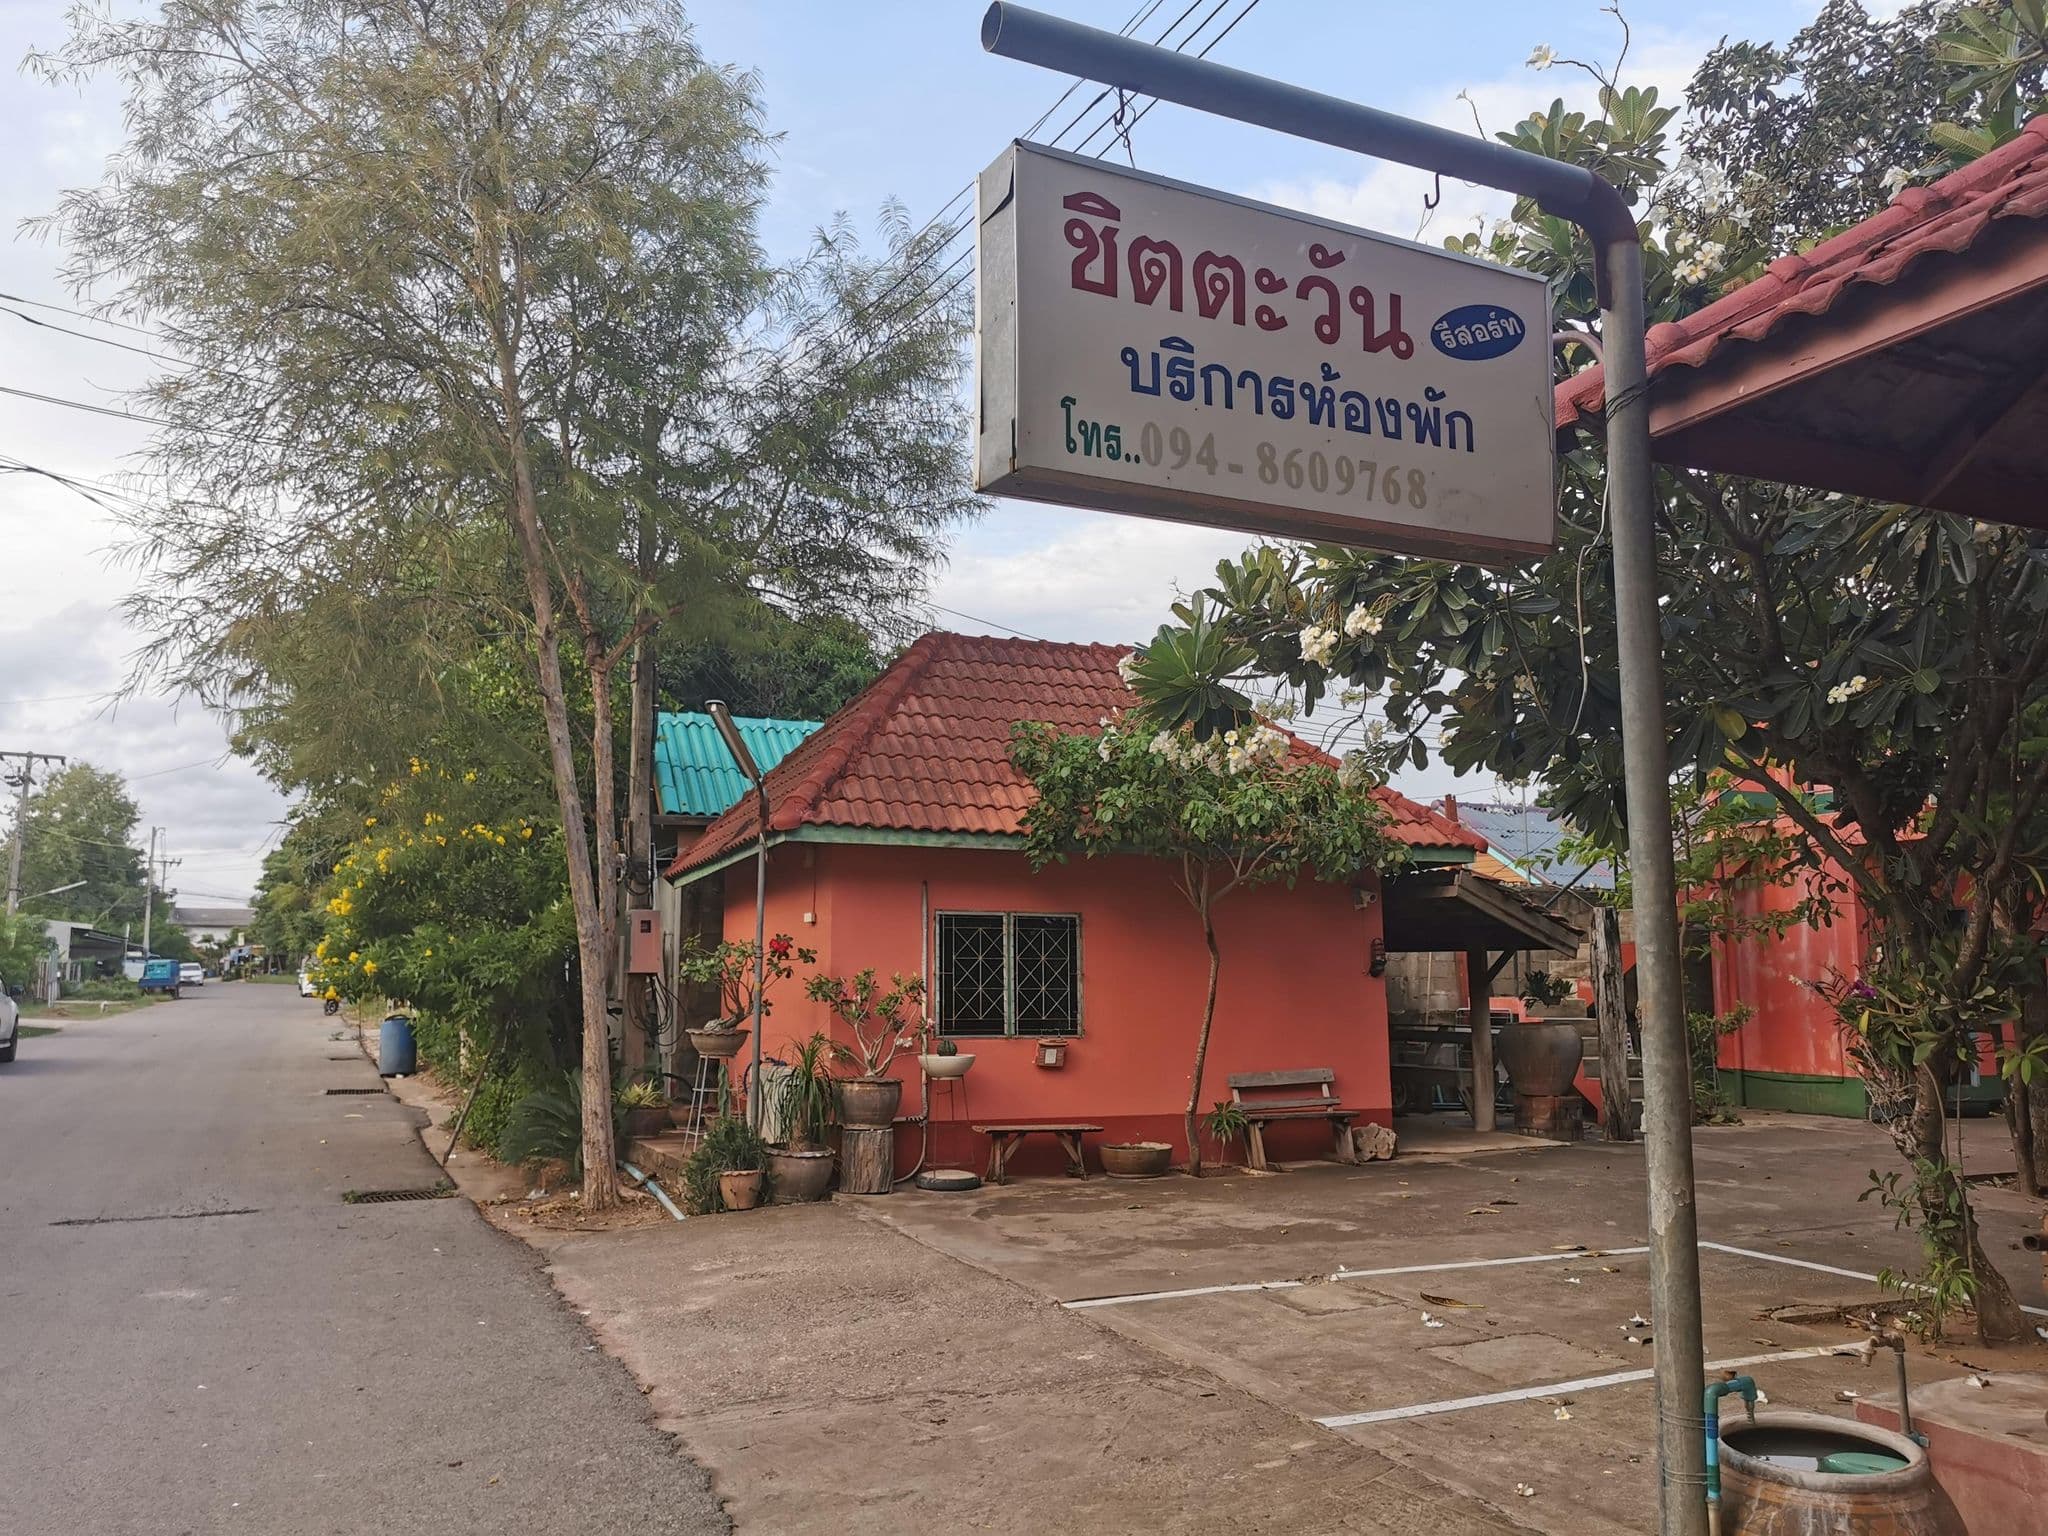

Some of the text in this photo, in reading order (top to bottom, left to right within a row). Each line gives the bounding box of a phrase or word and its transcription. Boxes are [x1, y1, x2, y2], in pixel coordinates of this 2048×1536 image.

[1063, 191, 1415, 361] ชิตตะวัน
[1433, 311, 1522, 349] รีสอร์ท
[1120, 336, 1475, 453] บริการห้องพัก
